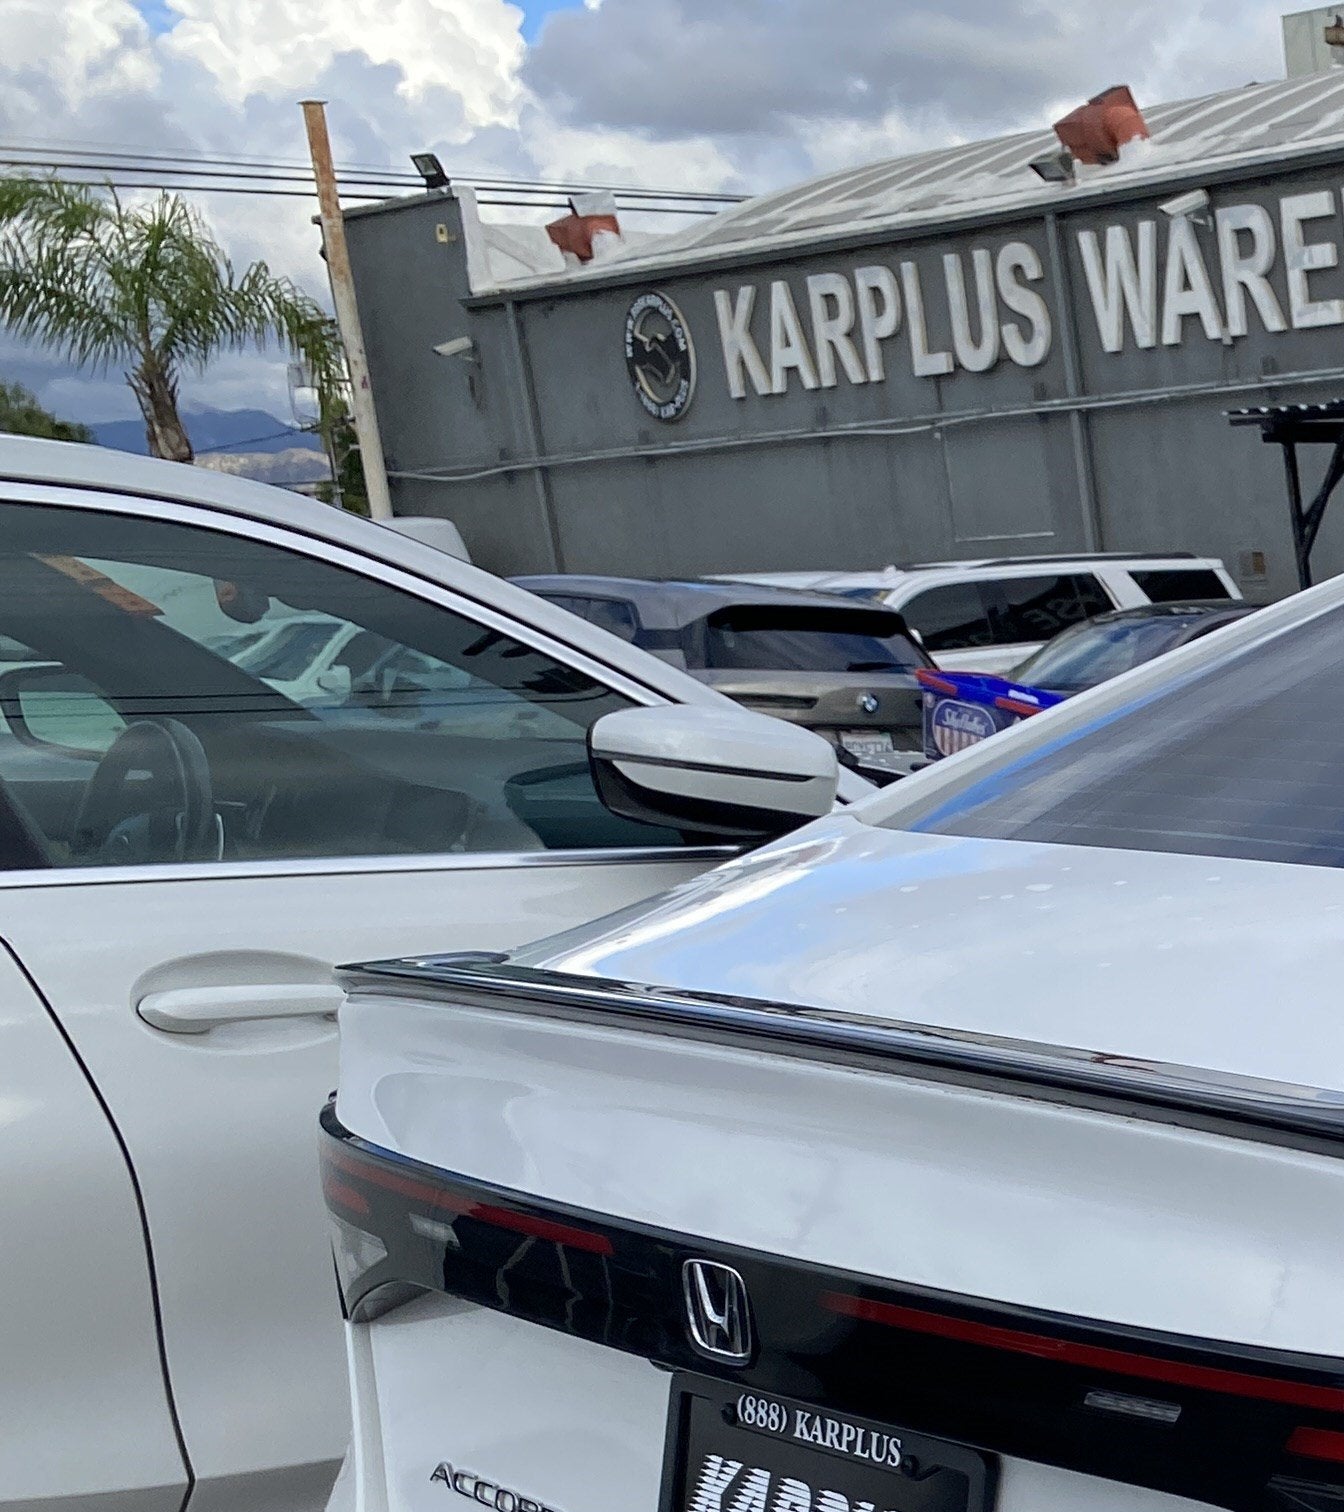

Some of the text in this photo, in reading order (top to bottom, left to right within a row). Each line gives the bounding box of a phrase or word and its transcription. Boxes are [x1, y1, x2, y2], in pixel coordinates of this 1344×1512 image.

[714, 242, 1052, 399] KARPLUS
[737, 1393, 901, 1467] (888) KARPLUS
